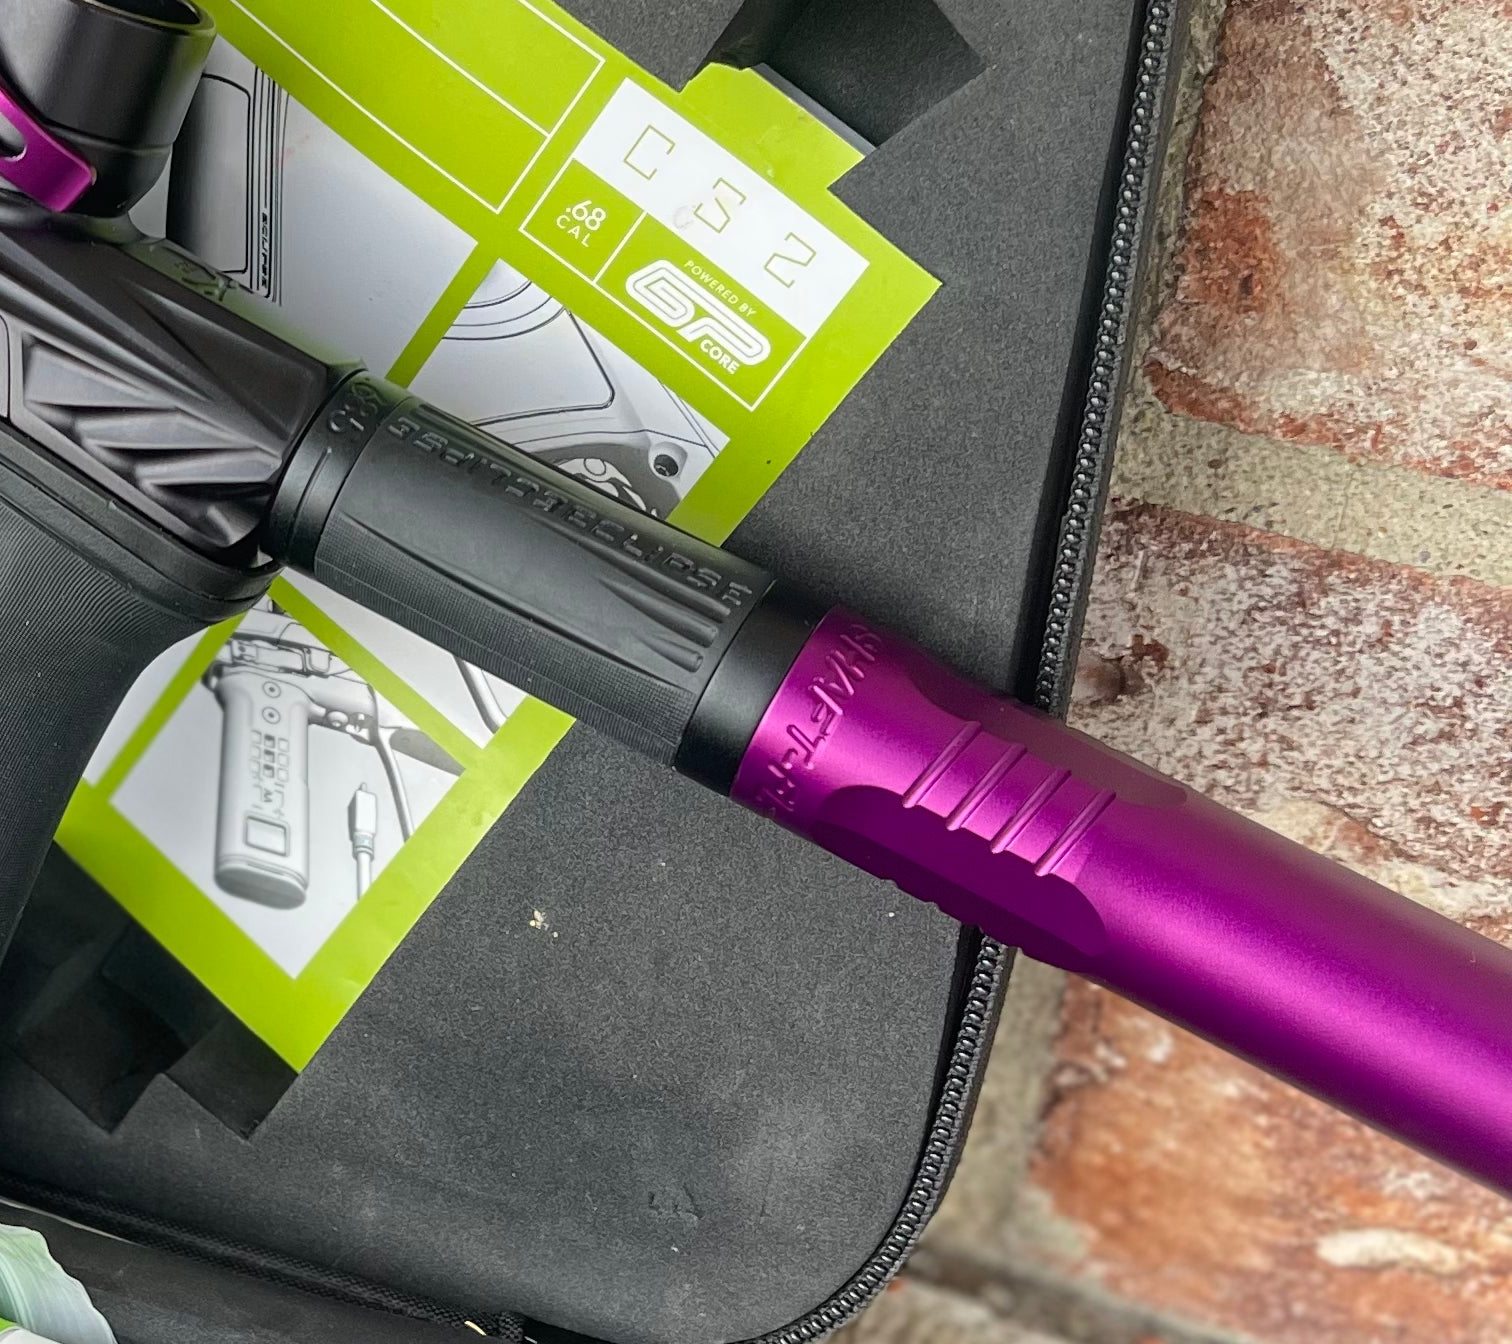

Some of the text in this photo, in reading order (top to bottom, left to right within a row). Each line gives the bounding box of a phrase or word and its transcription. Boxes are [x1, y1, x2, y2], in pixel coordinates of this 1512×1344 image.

[556, 214, 595, 247] CAL
[565, 200, 607, 231] .68
[684, 260, 756, 317] POWERED BY
[700, 339, 739, 375] CORE
